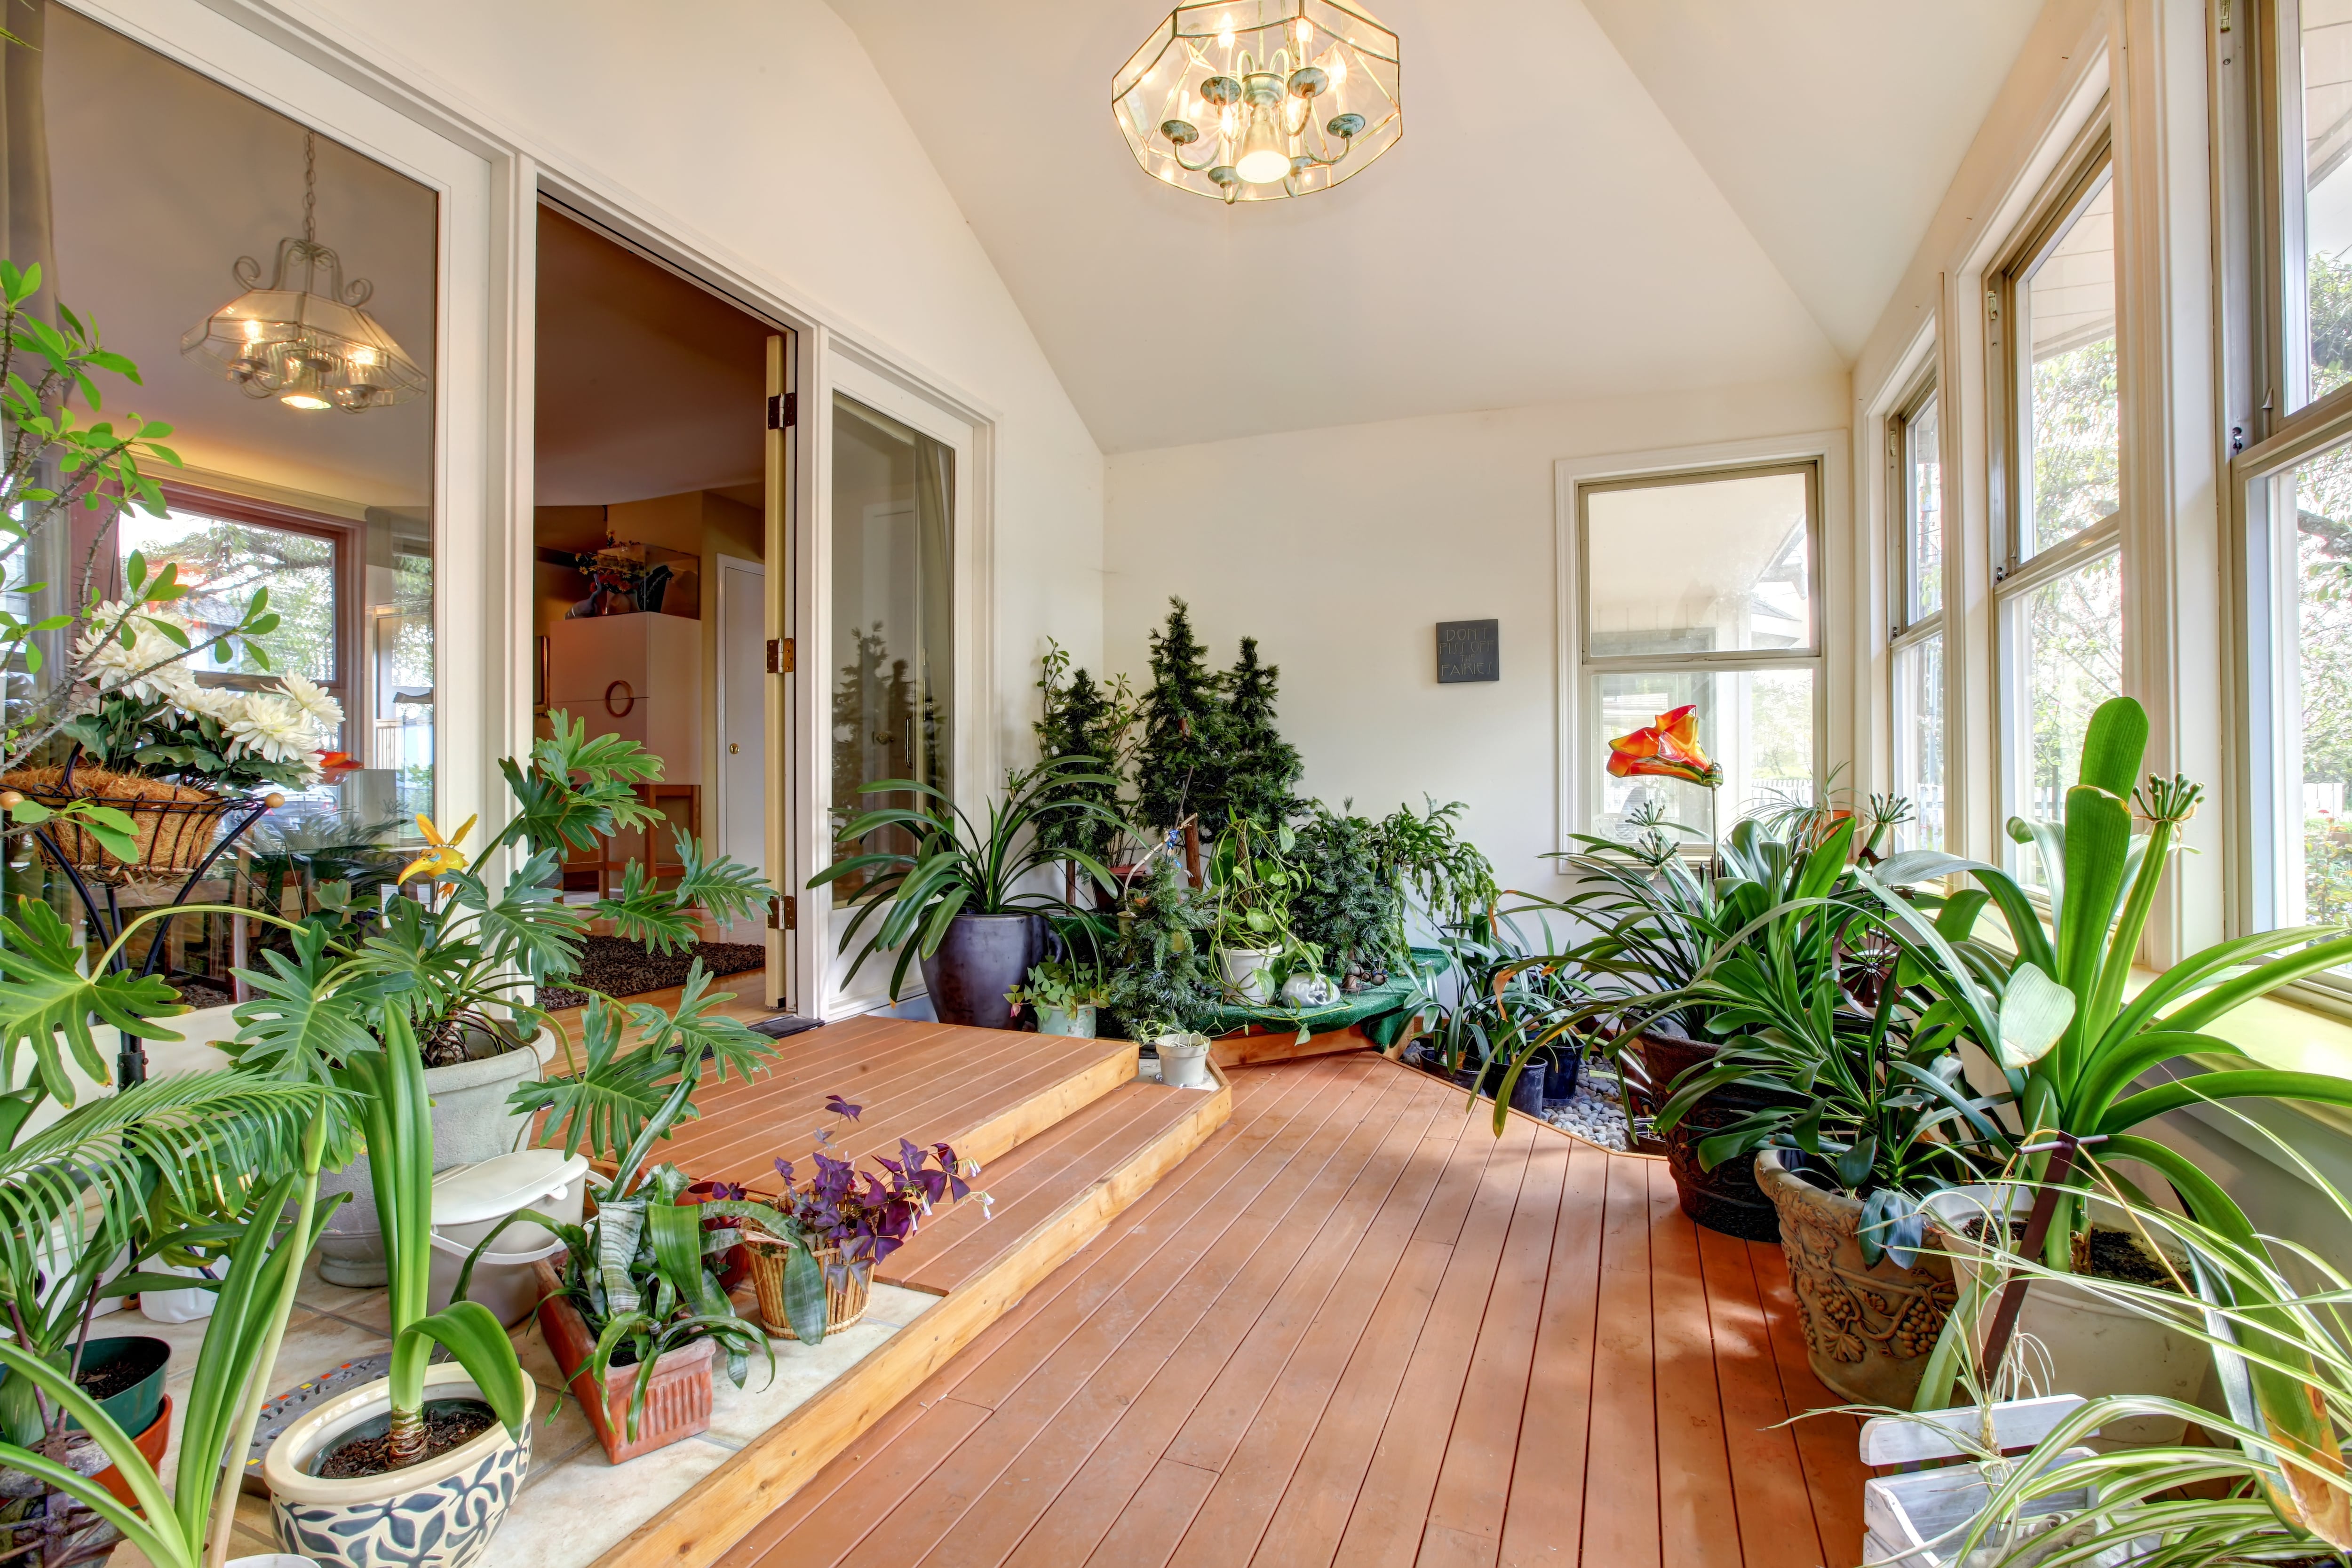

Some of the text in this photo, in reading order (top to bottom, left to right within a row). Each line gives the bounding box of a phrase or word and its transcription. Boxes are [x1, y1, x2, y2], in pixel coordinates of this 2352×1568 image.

[1439, 640, 1494, 654] PISS OFF
[1460, 654, 1476, 662] THE
[1441, 662, 1492, 677] FAIRIES
